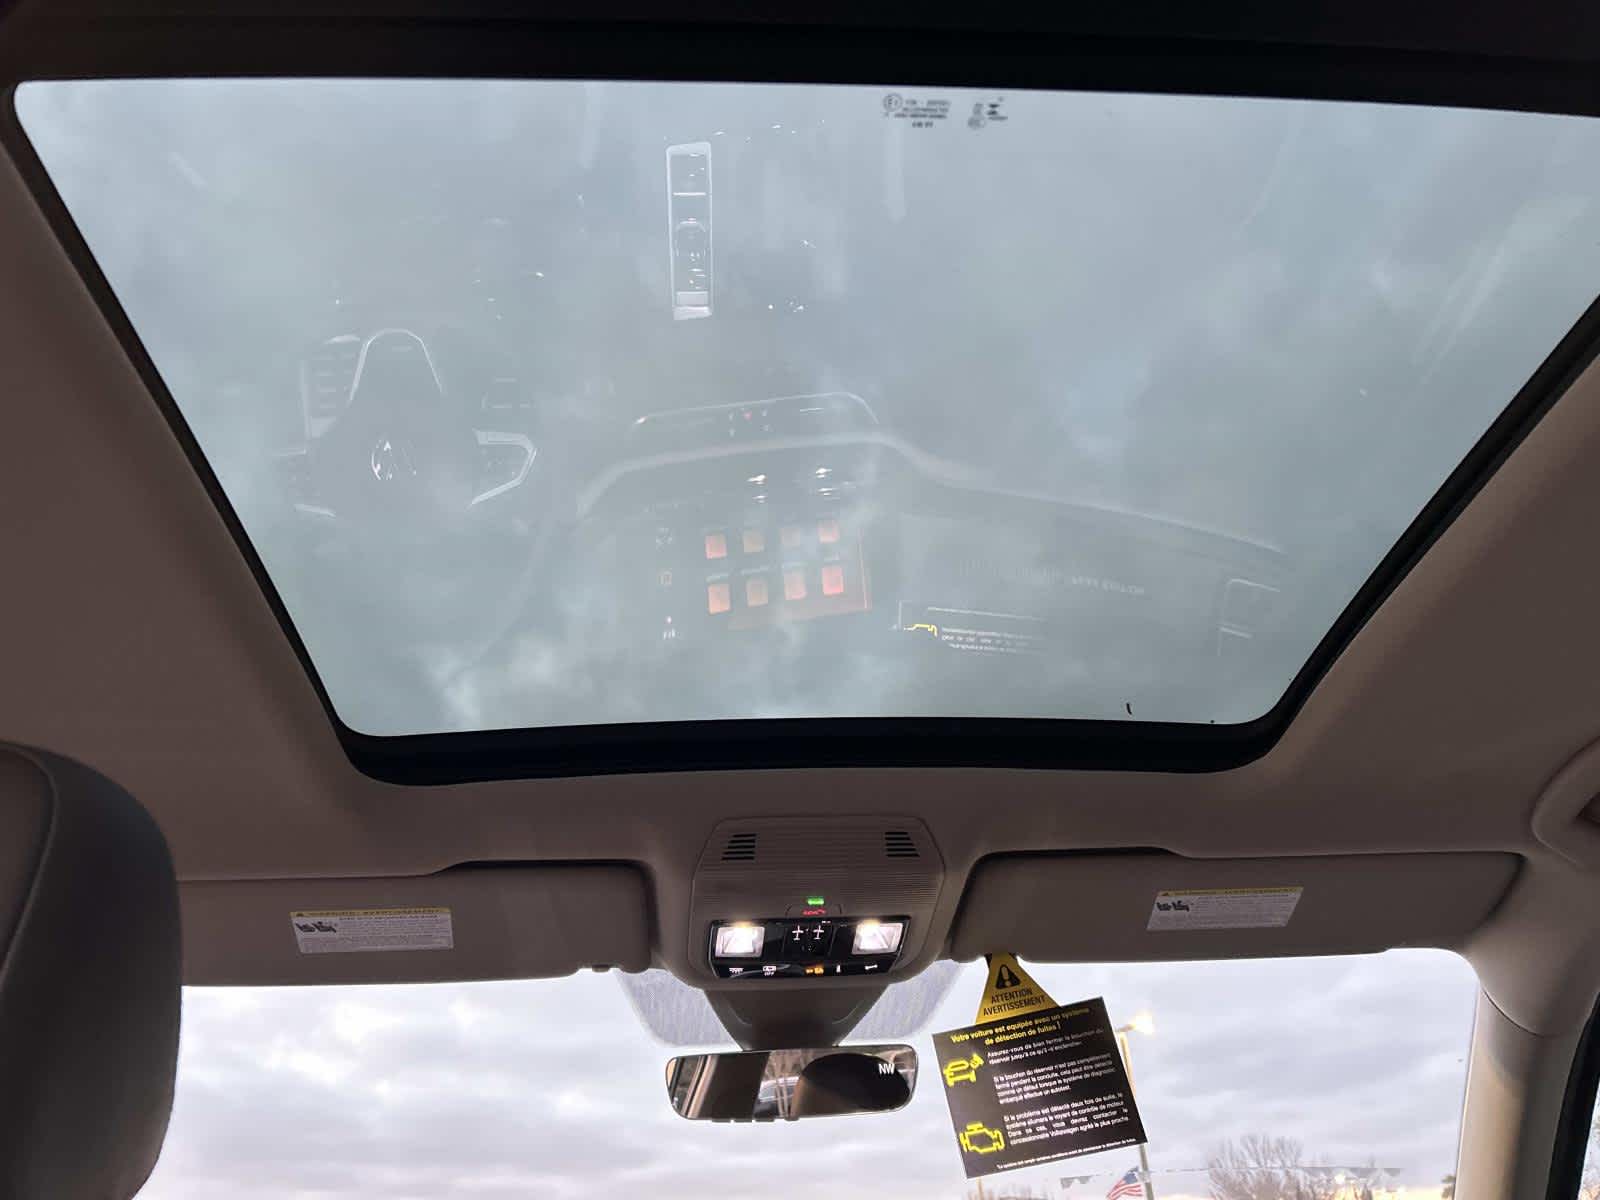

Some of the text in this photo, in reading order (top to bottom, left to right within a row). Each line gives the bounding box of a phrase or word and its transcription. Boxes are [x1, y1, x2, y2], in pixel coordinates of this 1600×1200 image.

[992, 987, 1032, 1004] ATTENTION
[983, 995, 1045, 1016] AVERTISSEMENT
[950, 1034, 969, 1043] Votre
[969, 1029, 993, 1039] voiture
[994, 1025, 1005, 1033] est
[994, 1031, 1026, 1043] détection
[1037, 1025, 1056, 1033] fuites
[878, 1063, 895, 1075] NW
